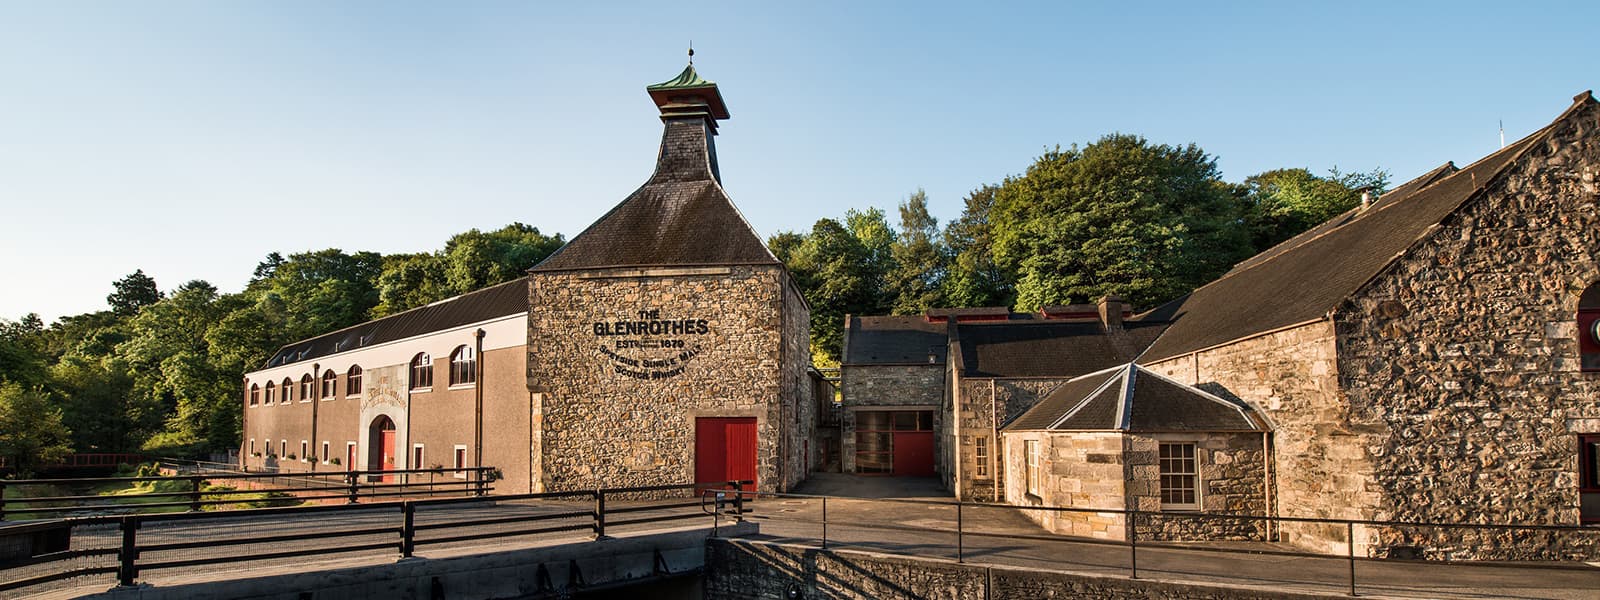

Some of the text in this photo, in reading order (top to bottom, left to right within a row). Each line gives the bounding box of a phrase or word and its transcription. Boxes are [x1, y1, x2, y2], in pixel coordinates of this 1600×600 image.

[639, 309, 660, 319] THE
[593, 320, 709, 335] GLENROTHES
[660, 340, 685, 349] 1879
[679, 344, 703, 361] MALT
[614, 365, 686, 380] SCOTCH WHISKY
